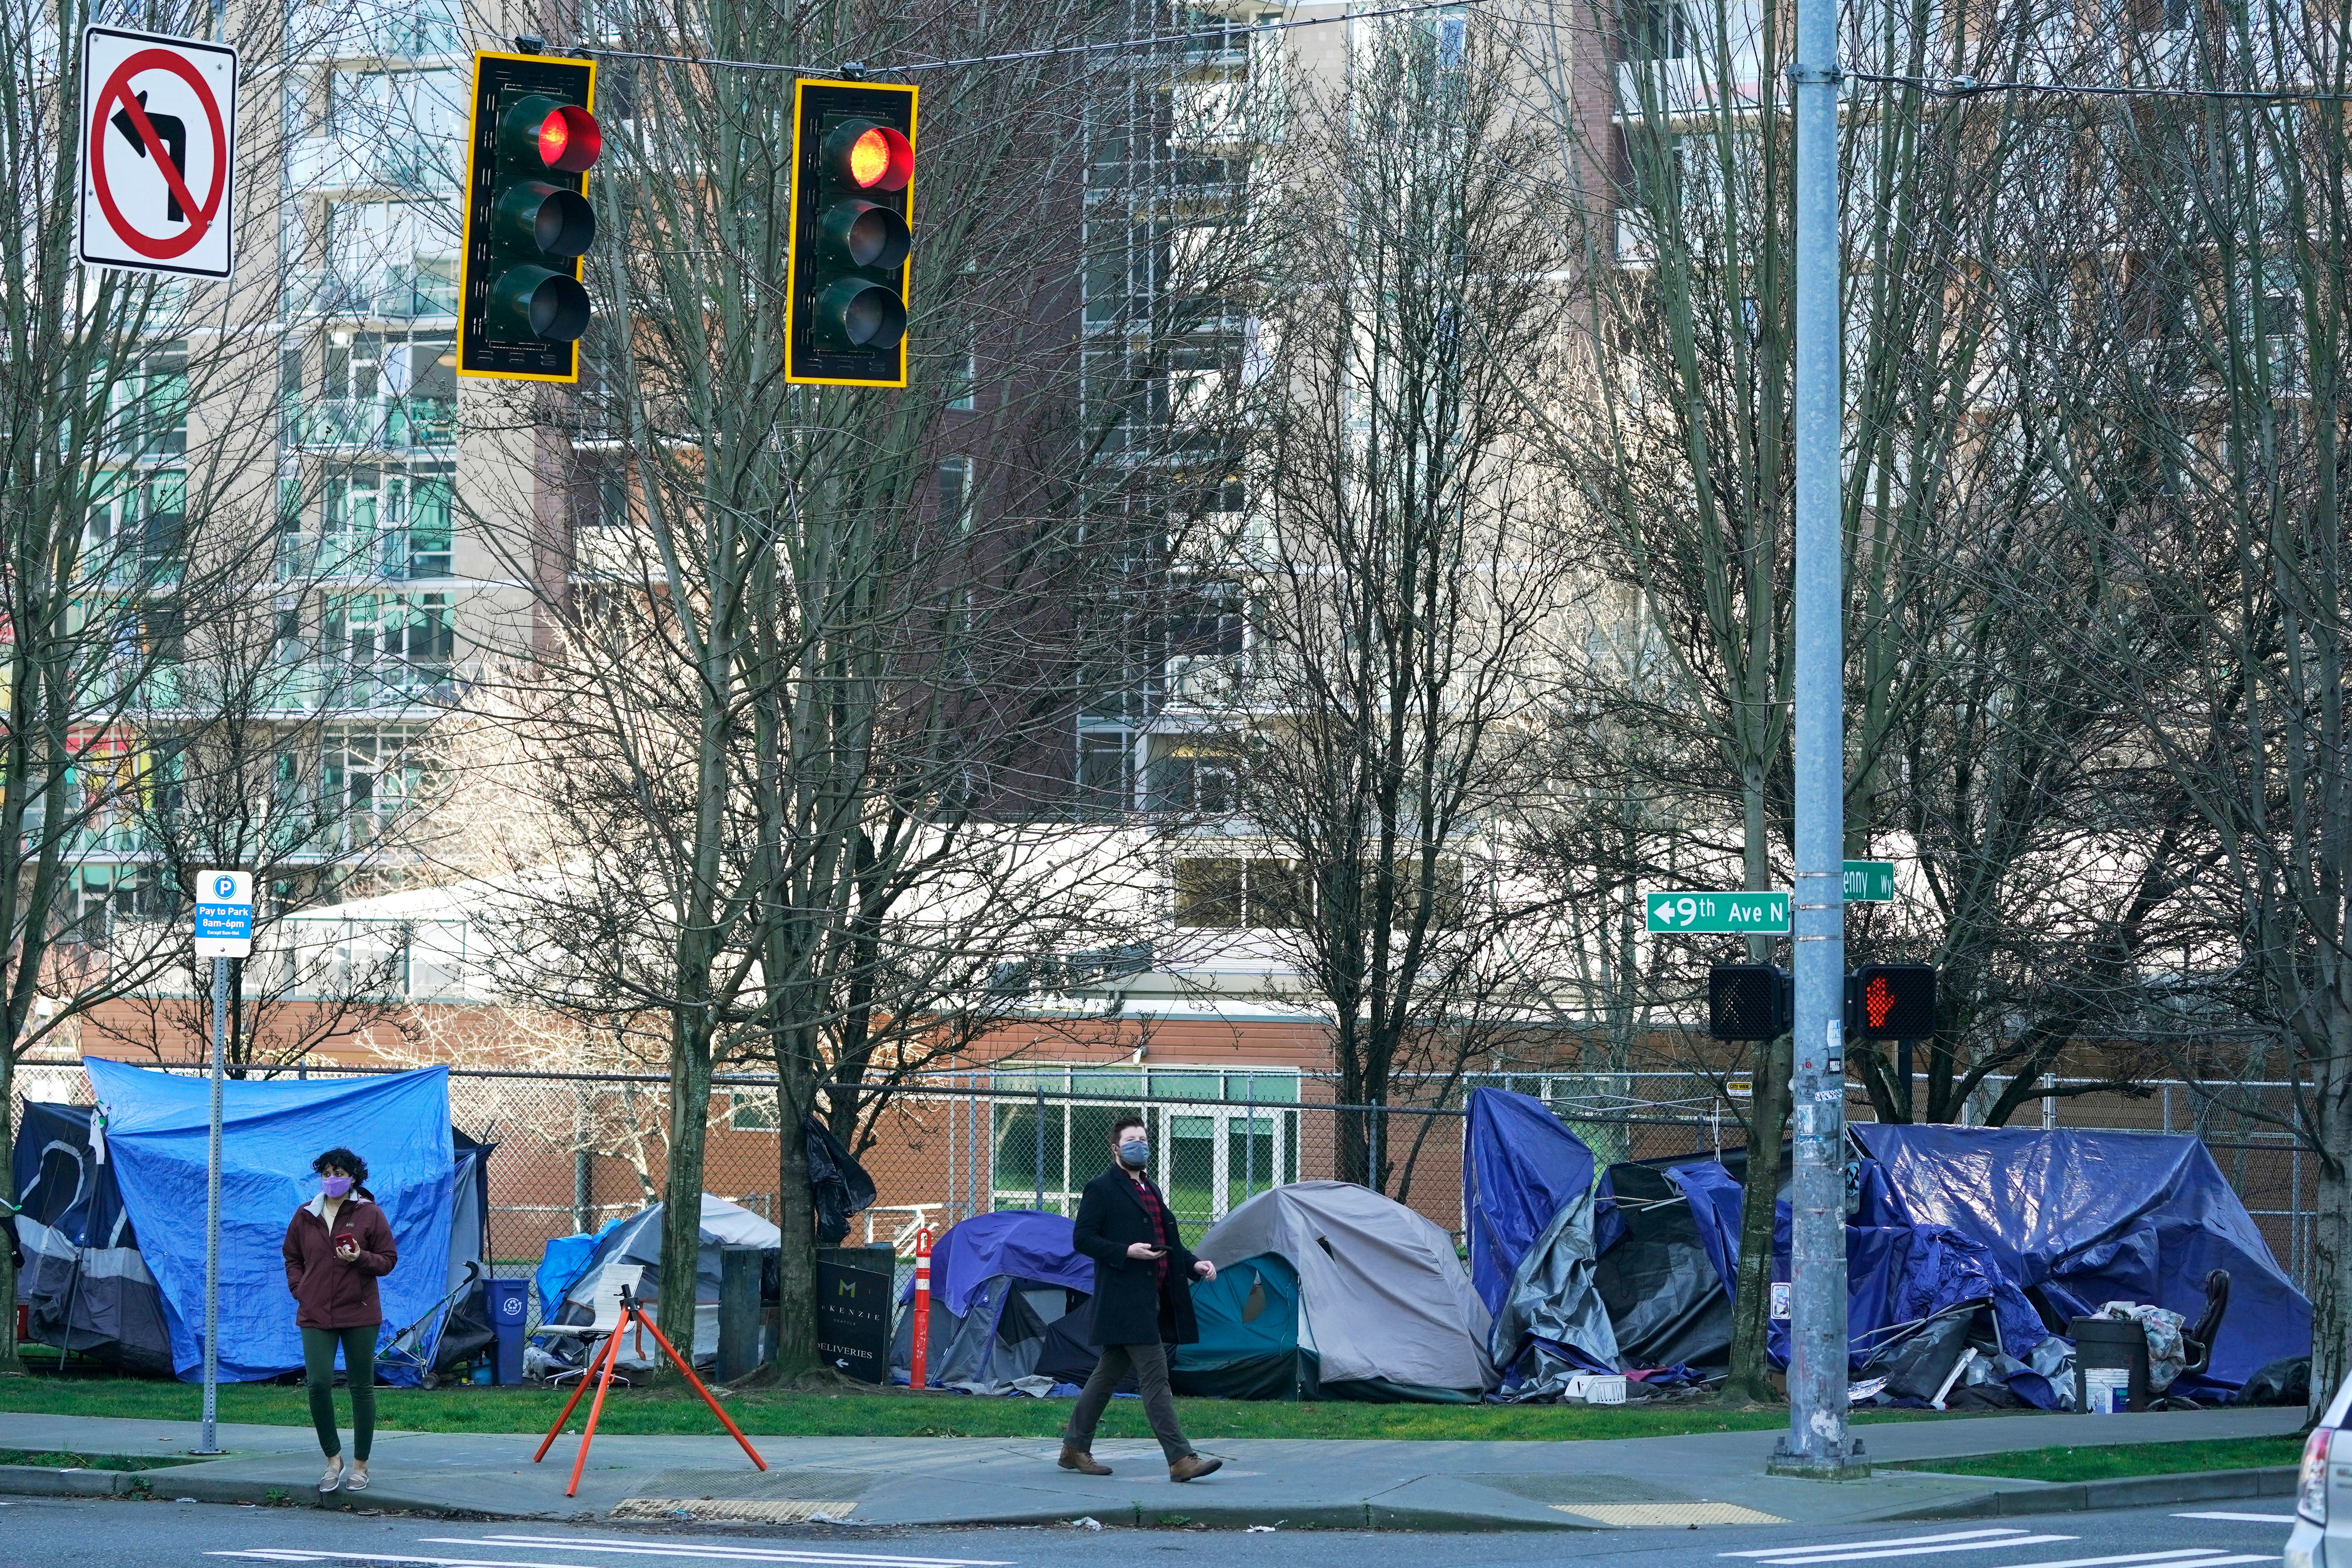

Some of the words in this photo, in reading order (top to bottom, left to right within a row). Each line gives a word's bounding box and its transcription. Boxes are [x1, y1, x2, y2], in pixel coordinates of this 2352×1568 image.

[220, 880, 231, 895] P
[1843, 871, 1868, 899] enny
[1881, 874, 1892, 899] Wy
[199, 906, 215, 917] Pay
[217, 907, 226, 915] to
[228, 907, 249, 916] Park
[1677, 898, 1715, 926] 9th
[1728, 903, 1762, 922] Ave
[1770, 902, 1783, 922] N
[202, 918, 245, 929] 8am-6pm
[839, 1279, 856, 1298] M
[822, 1305, 880, 1321] cKENZIE
